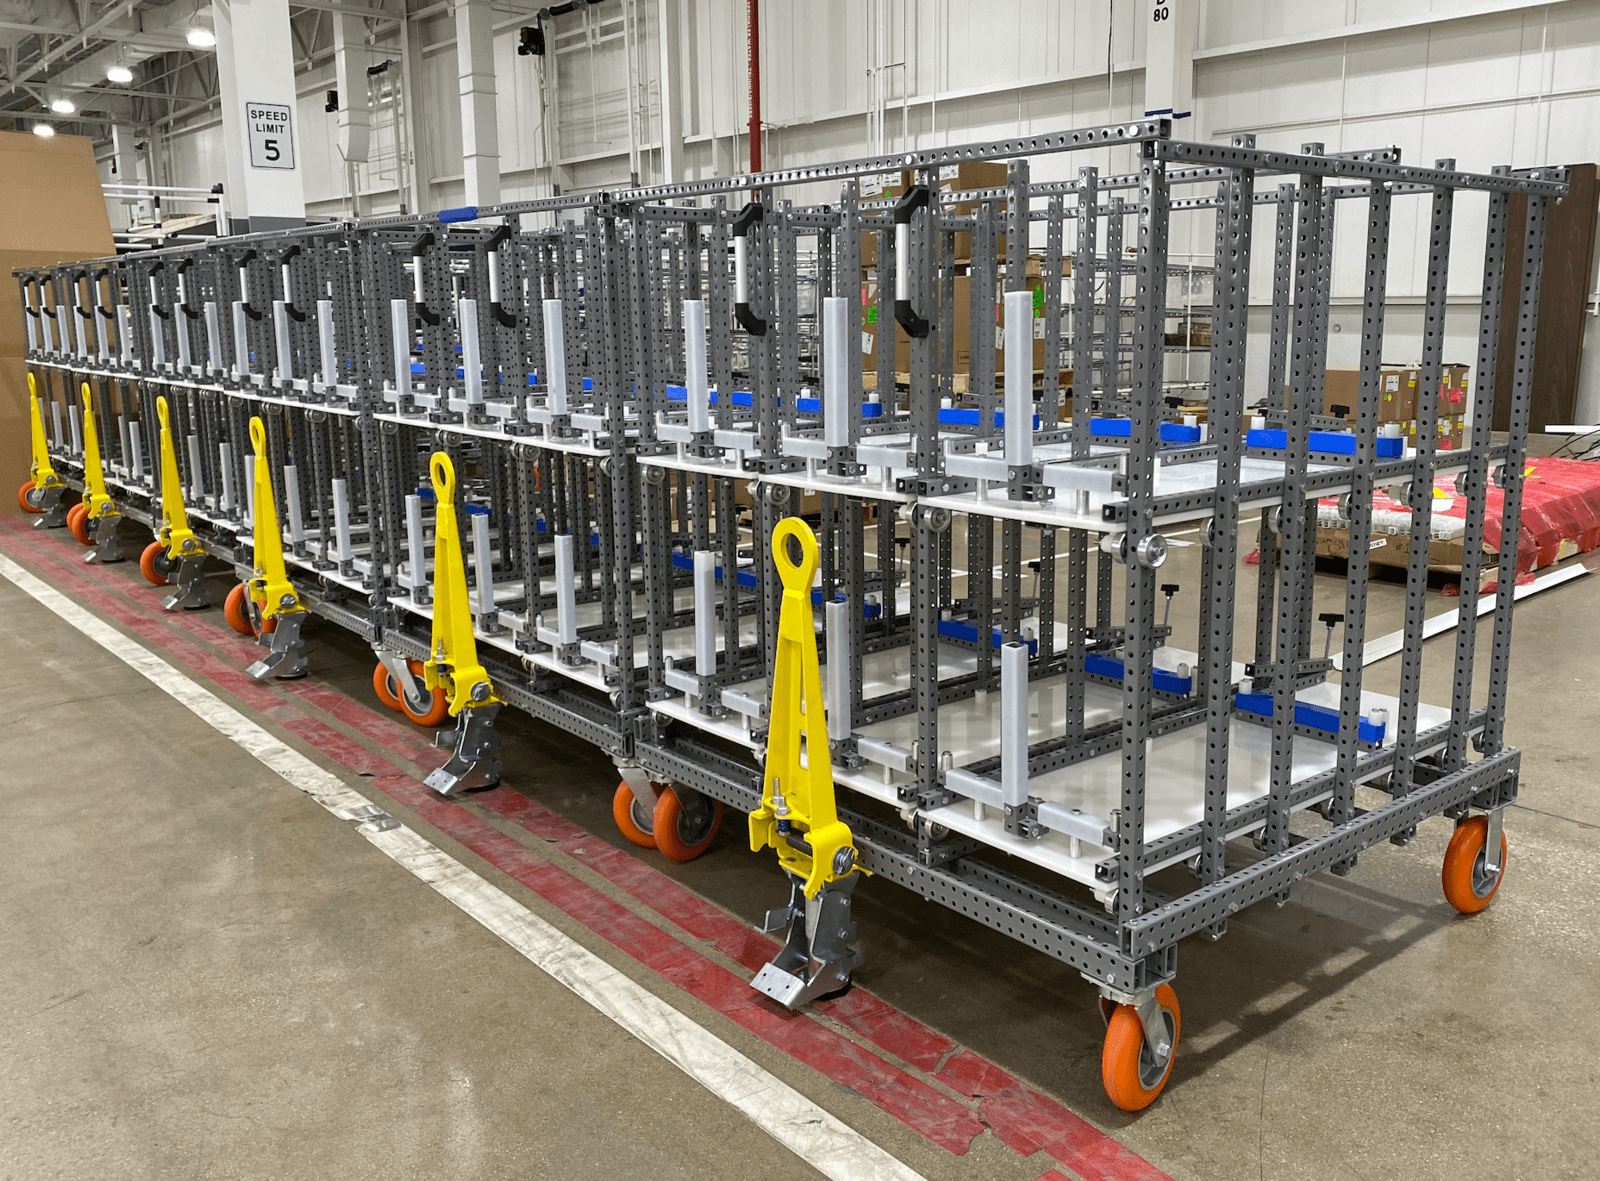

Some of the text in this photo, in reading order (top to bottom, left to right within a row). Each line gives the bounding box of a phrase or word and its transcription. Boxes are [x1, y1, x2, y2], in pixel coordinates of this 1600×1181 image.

[1153, 7, 1169, 22] 80
[251, 110, 287, 121] SPEED
[256, 123, 285, 133] LIMIT
[265, 139, 280, 161] 5
